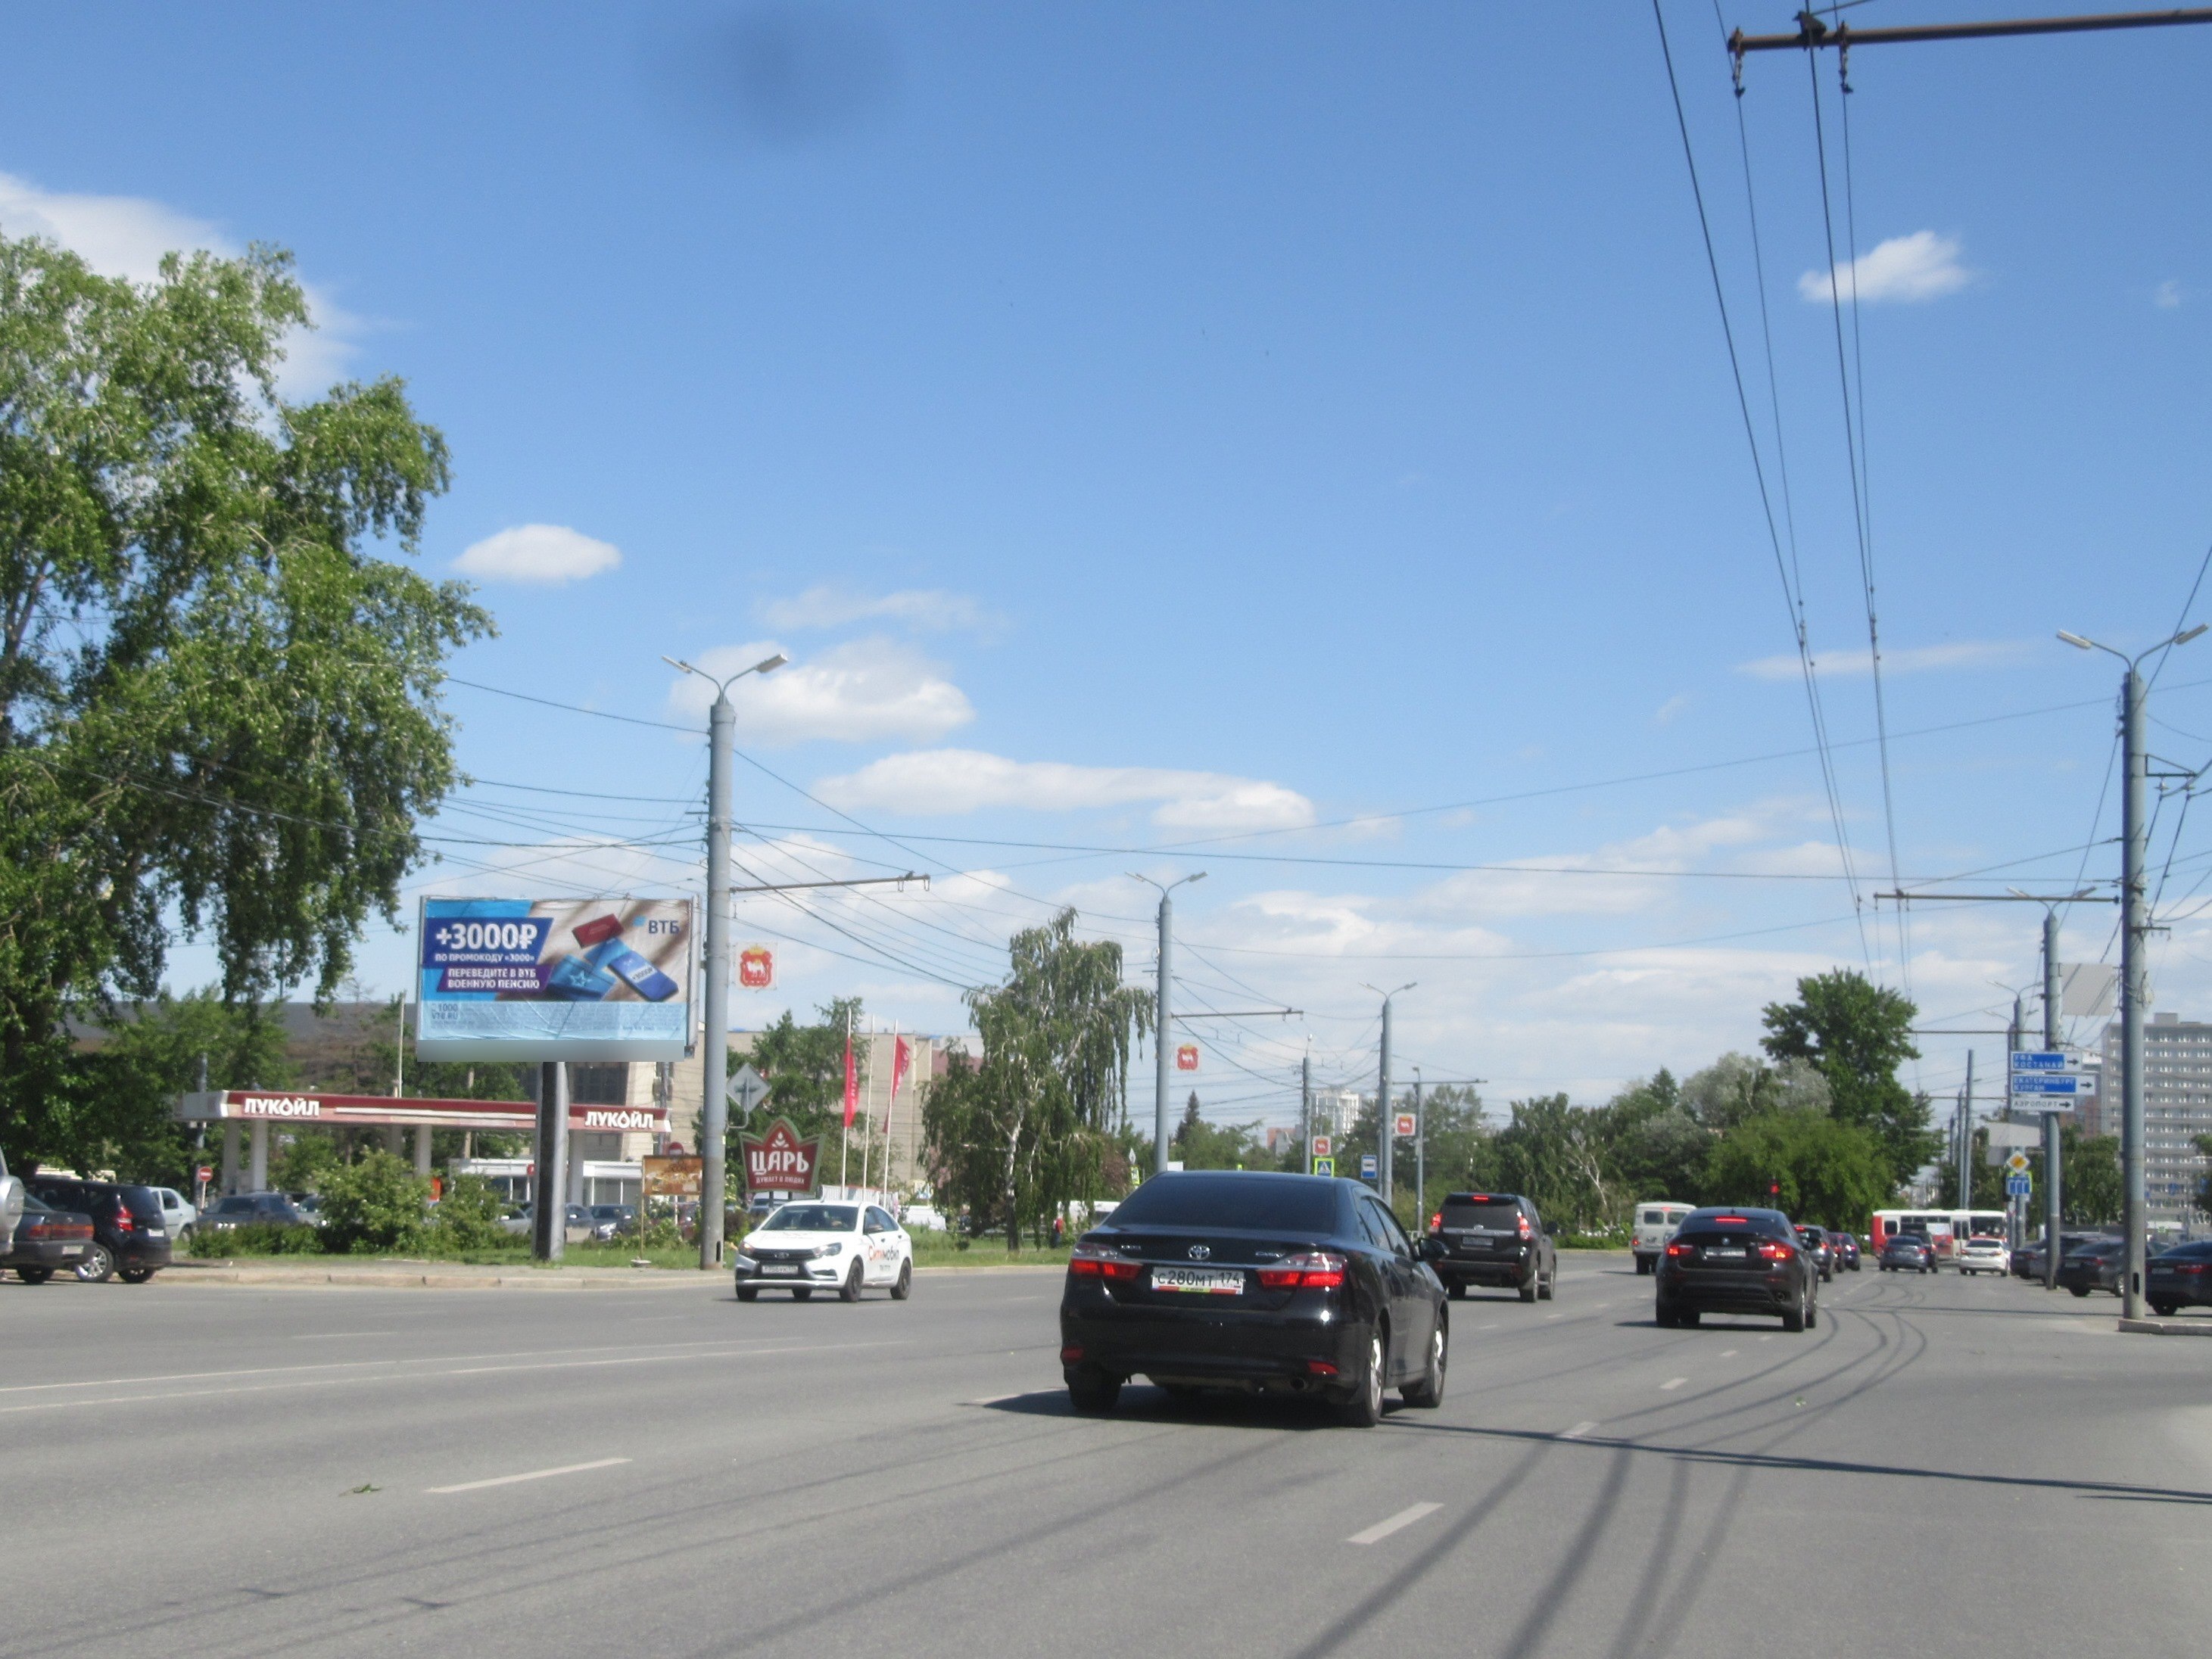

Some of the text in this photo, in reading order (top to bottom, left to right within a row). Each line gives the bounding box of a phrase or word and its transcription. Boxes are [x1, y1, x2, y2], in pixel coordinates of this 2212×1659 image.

[649, 920, 680, 934] ВТБ
[449, 954, 503, 963] ПРОМОКОДУ
[448, 968, 537, 979] ПЕРЕВЕДИТЕ В ВТБ
[447, 979, 541, 988] ВОЕННУЮ ПЕНСИЮ
[245, 1097, 319, 1116] ЛУКОЙЛ
[584, 1110, 654, 1128] ЛУКОЙЛ
[752, 1151, 809, 1175] ЦАРЬ
[1219, 1272, 1240, 1285] 174
